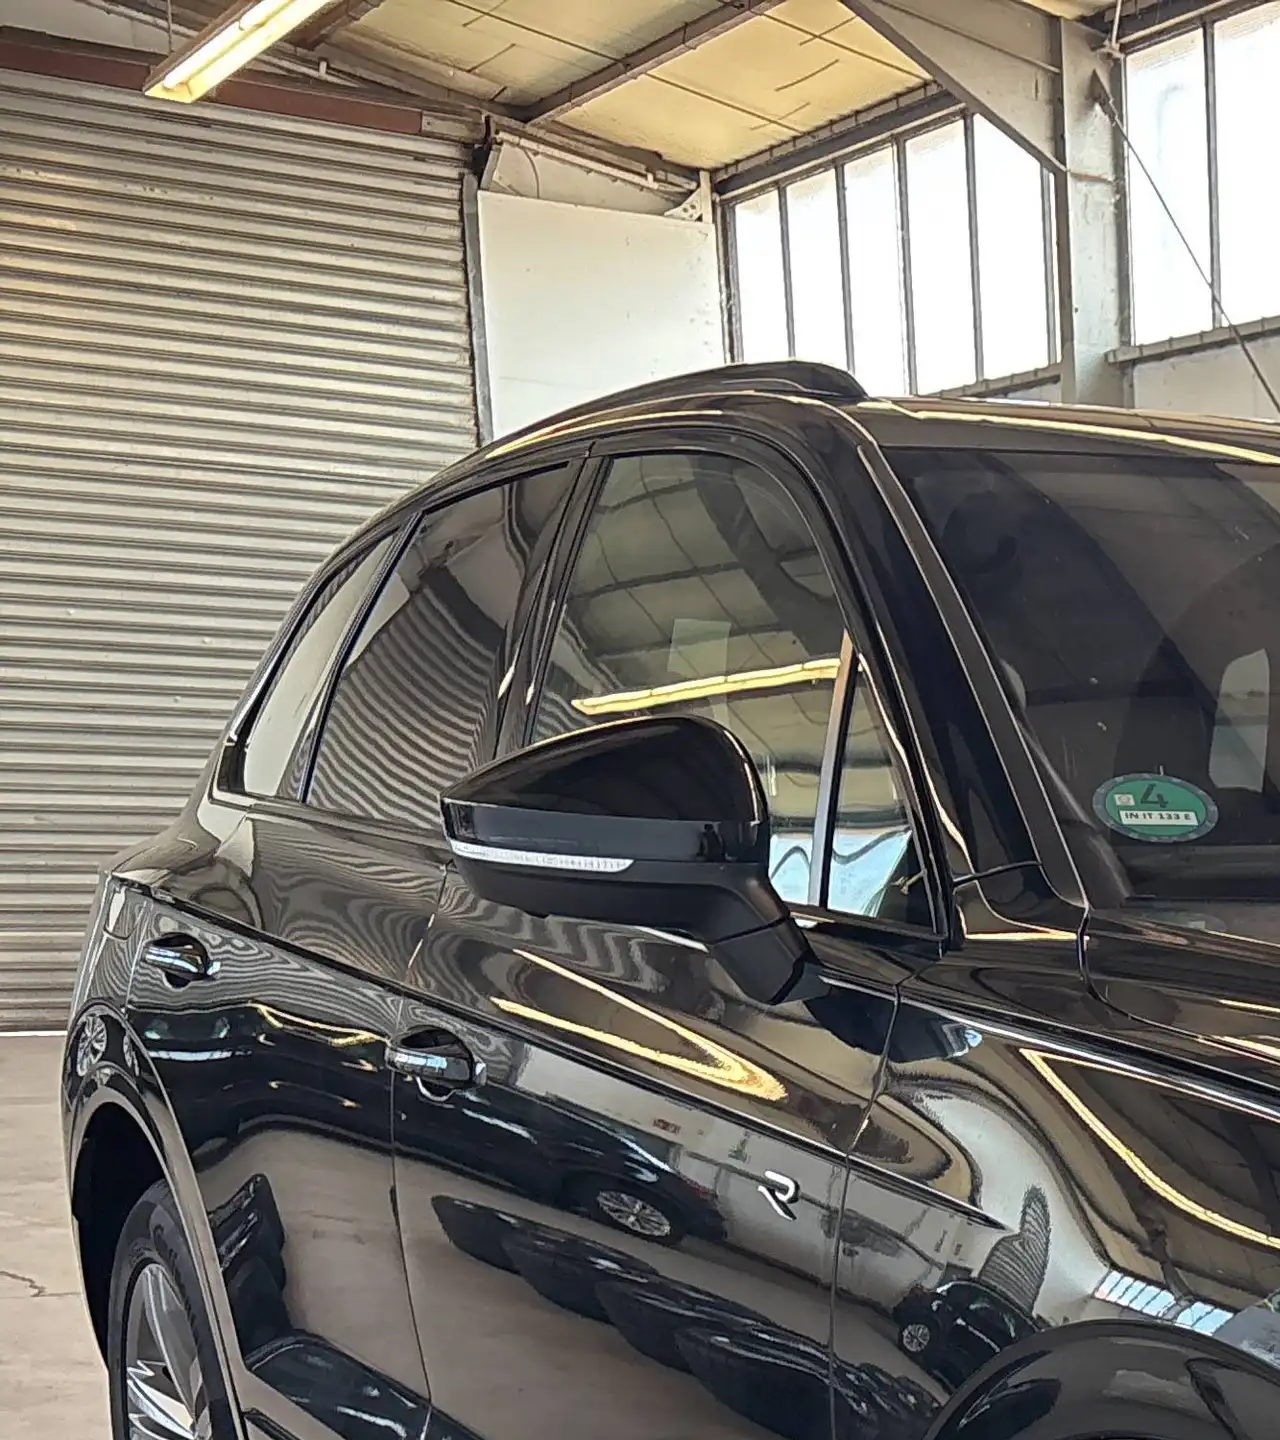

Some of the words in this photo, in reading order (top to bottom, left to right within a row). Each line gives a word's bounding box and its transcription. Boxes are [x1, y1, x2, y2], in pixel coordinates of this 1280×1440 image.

[1140, 783, 1169, 808] 4
[1124, 812, 1139, 820] IN
[1142, 812, 1154, 821] IT
[1156, 812, 1181, 821] 133
[1183, 812, 1192, 821] E
[757, 1169, 801, 1221] R
